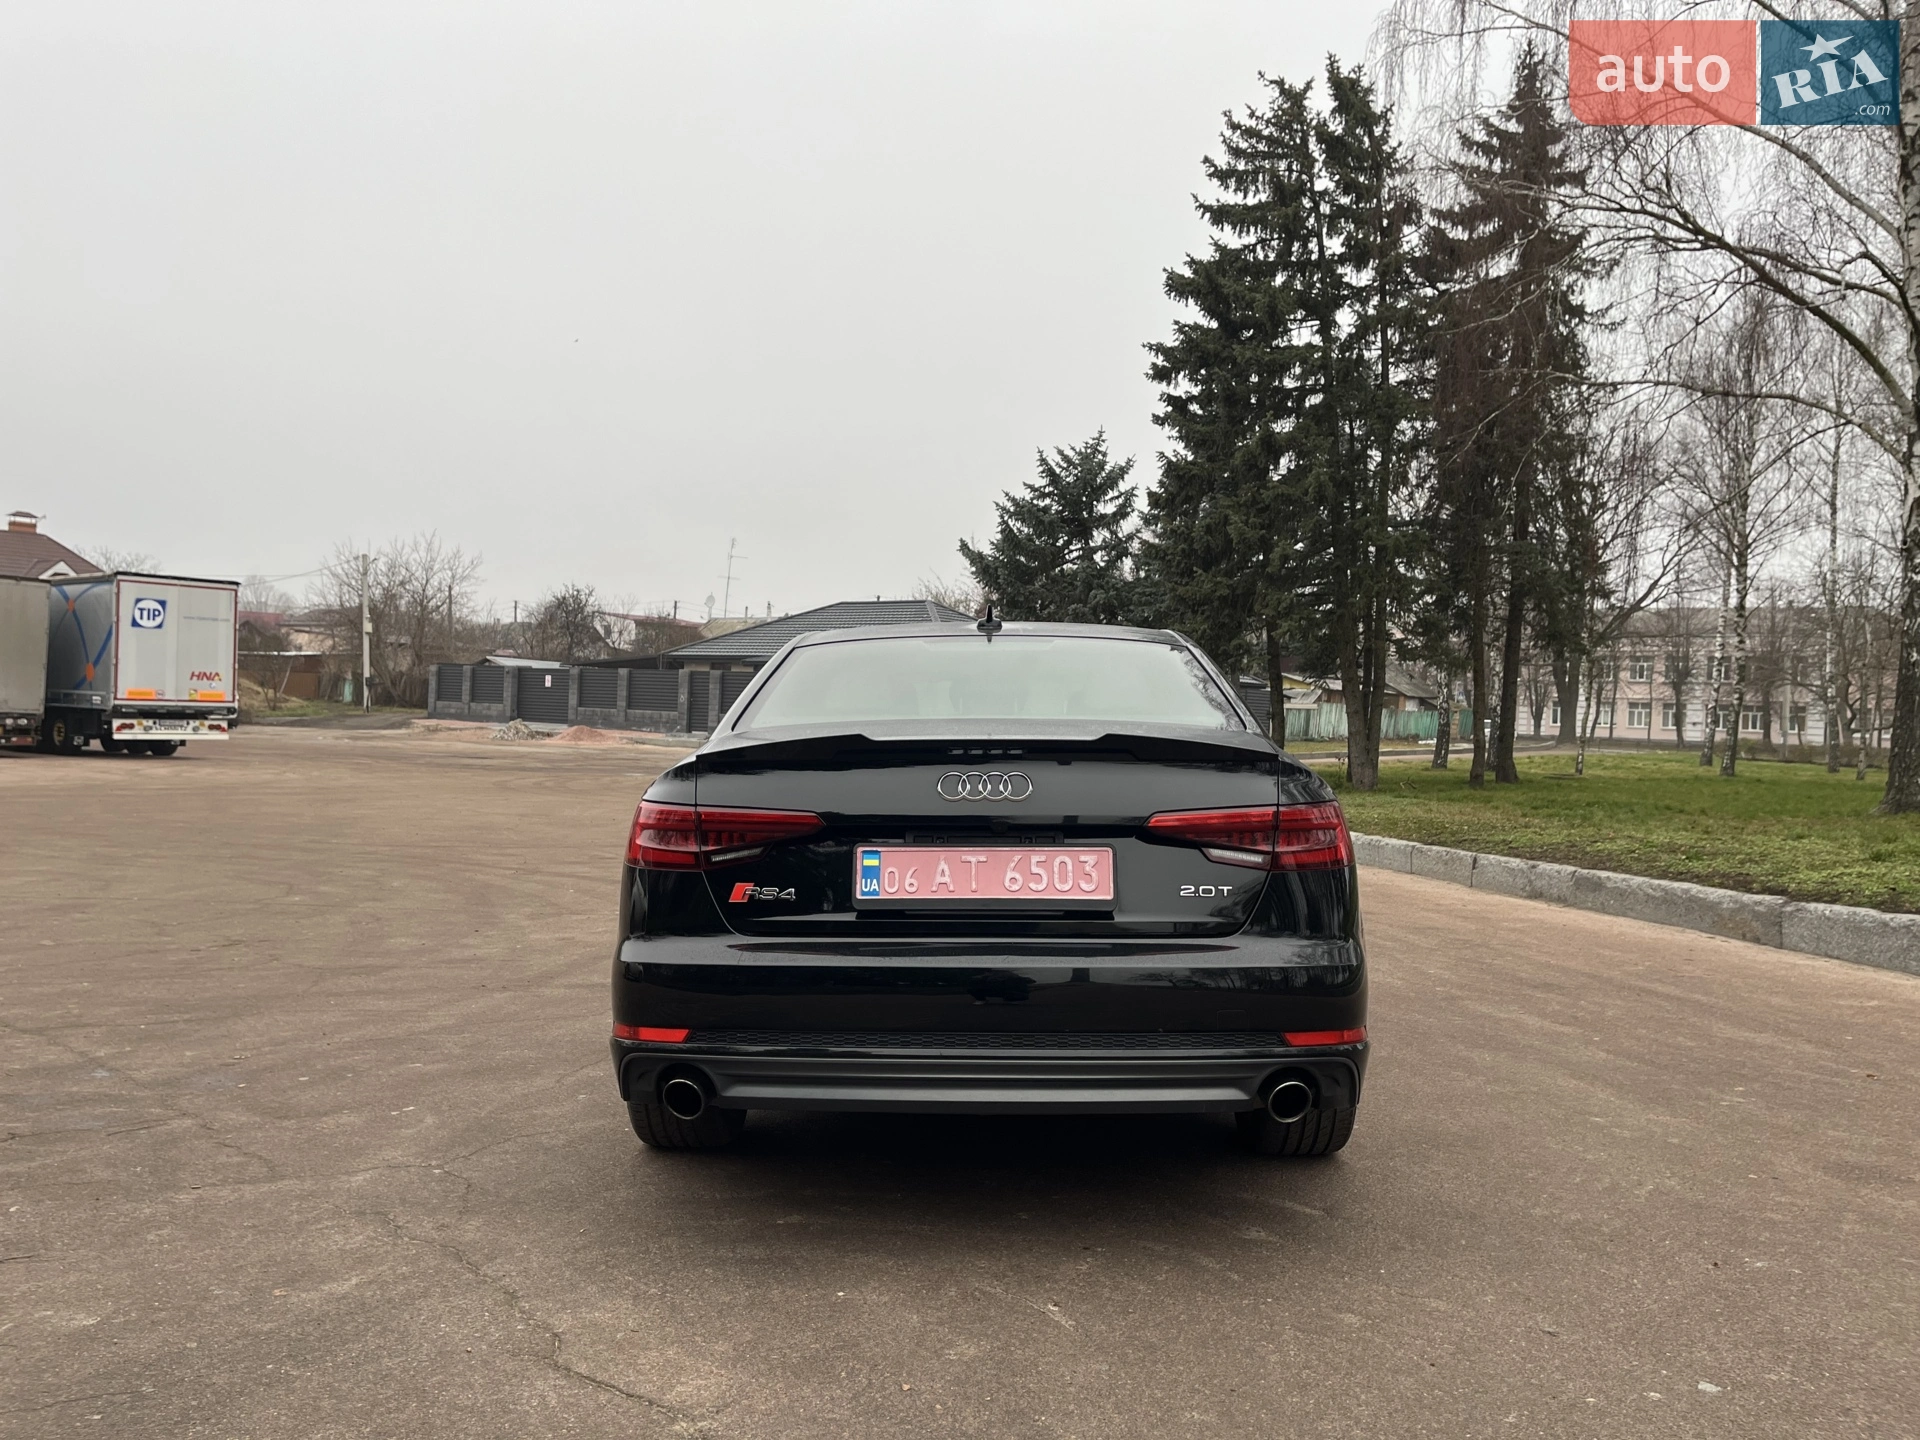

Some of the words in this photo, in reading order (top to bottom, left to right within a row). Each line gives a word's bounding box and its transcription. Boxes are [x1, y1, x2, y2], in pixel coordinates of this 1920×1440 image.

[137, 608, 162, 621] TIP
[189, 671, 222, 682] HNA
[883, 866, 919, 894] 06
[930, 855, 988, 892] AT
[1002, 855, 1100, 892] 6503
[861, 878, 880, 892] UA
[741, 886, 797, 901] RS4
